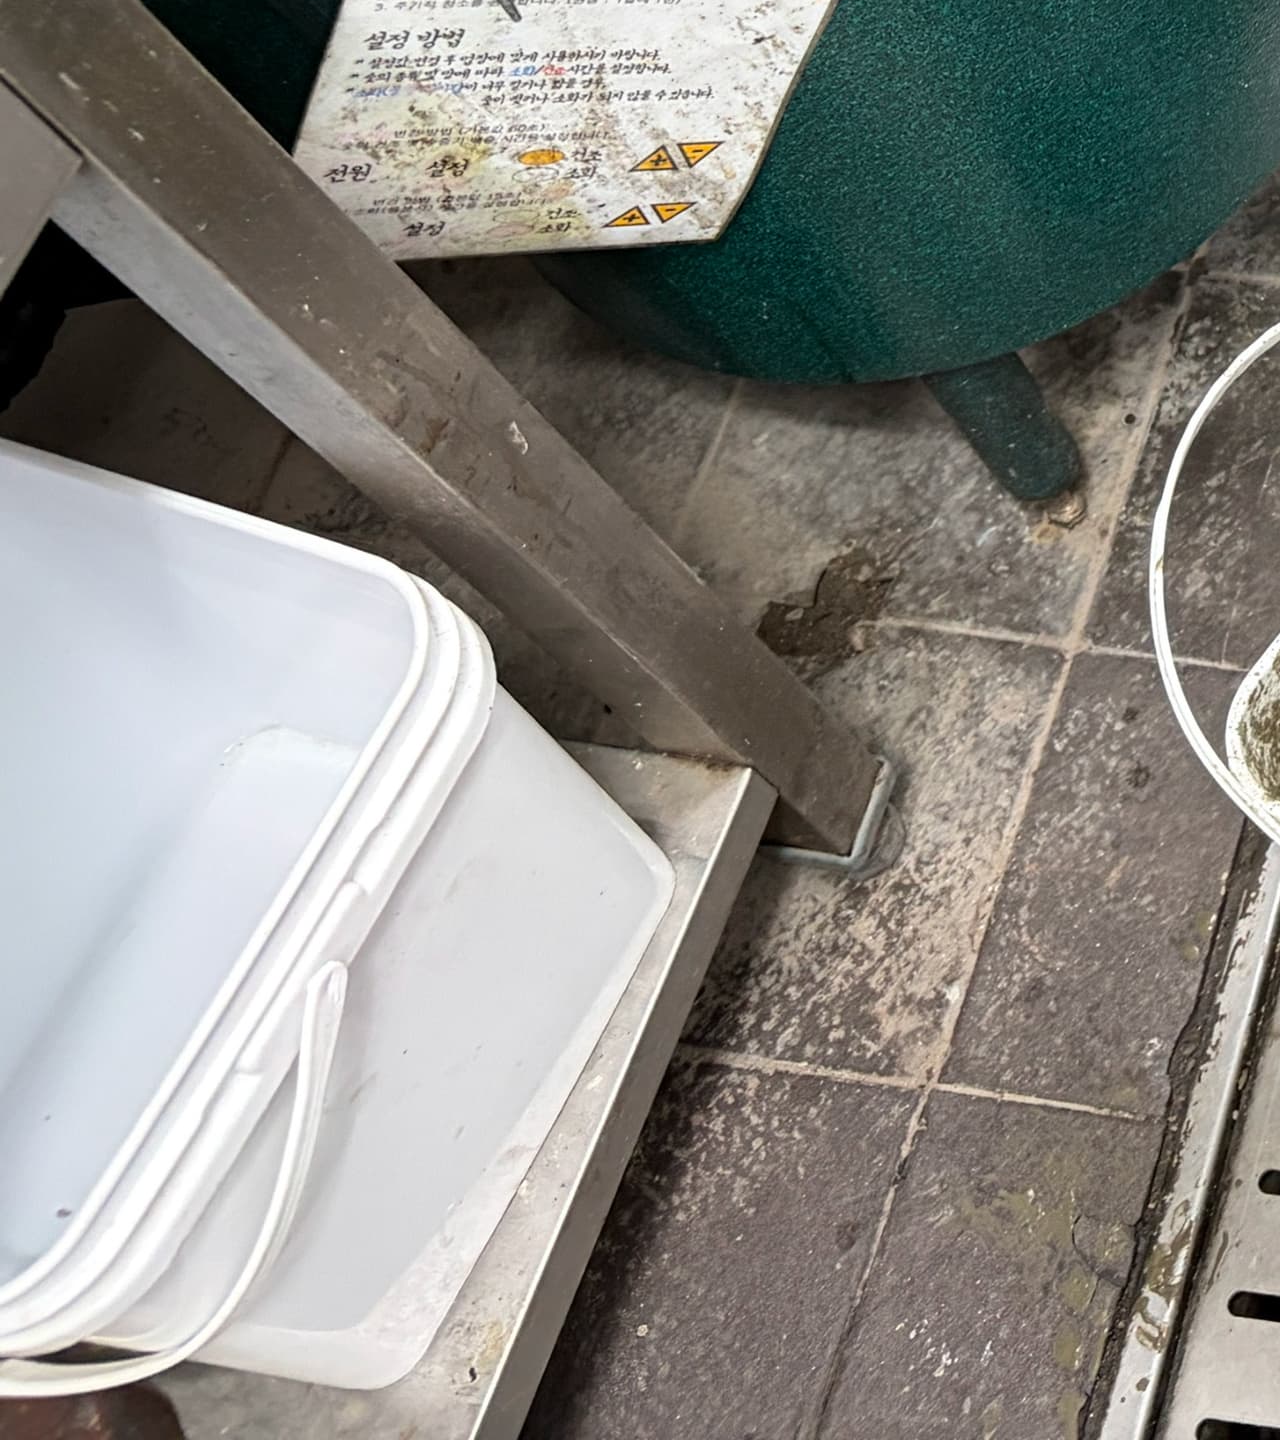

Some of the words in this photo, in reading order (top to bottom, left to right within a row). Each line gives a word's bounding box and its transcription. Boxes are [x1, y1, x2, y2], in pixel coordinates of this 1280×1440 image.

[363, 30, 410, 50] 설정
[417, 28, 465, 49] 방법
[324, 163, 372, 183] 전원
[427, 158, 469, 178] 설정
[403, 220, 446, 237] 설정
